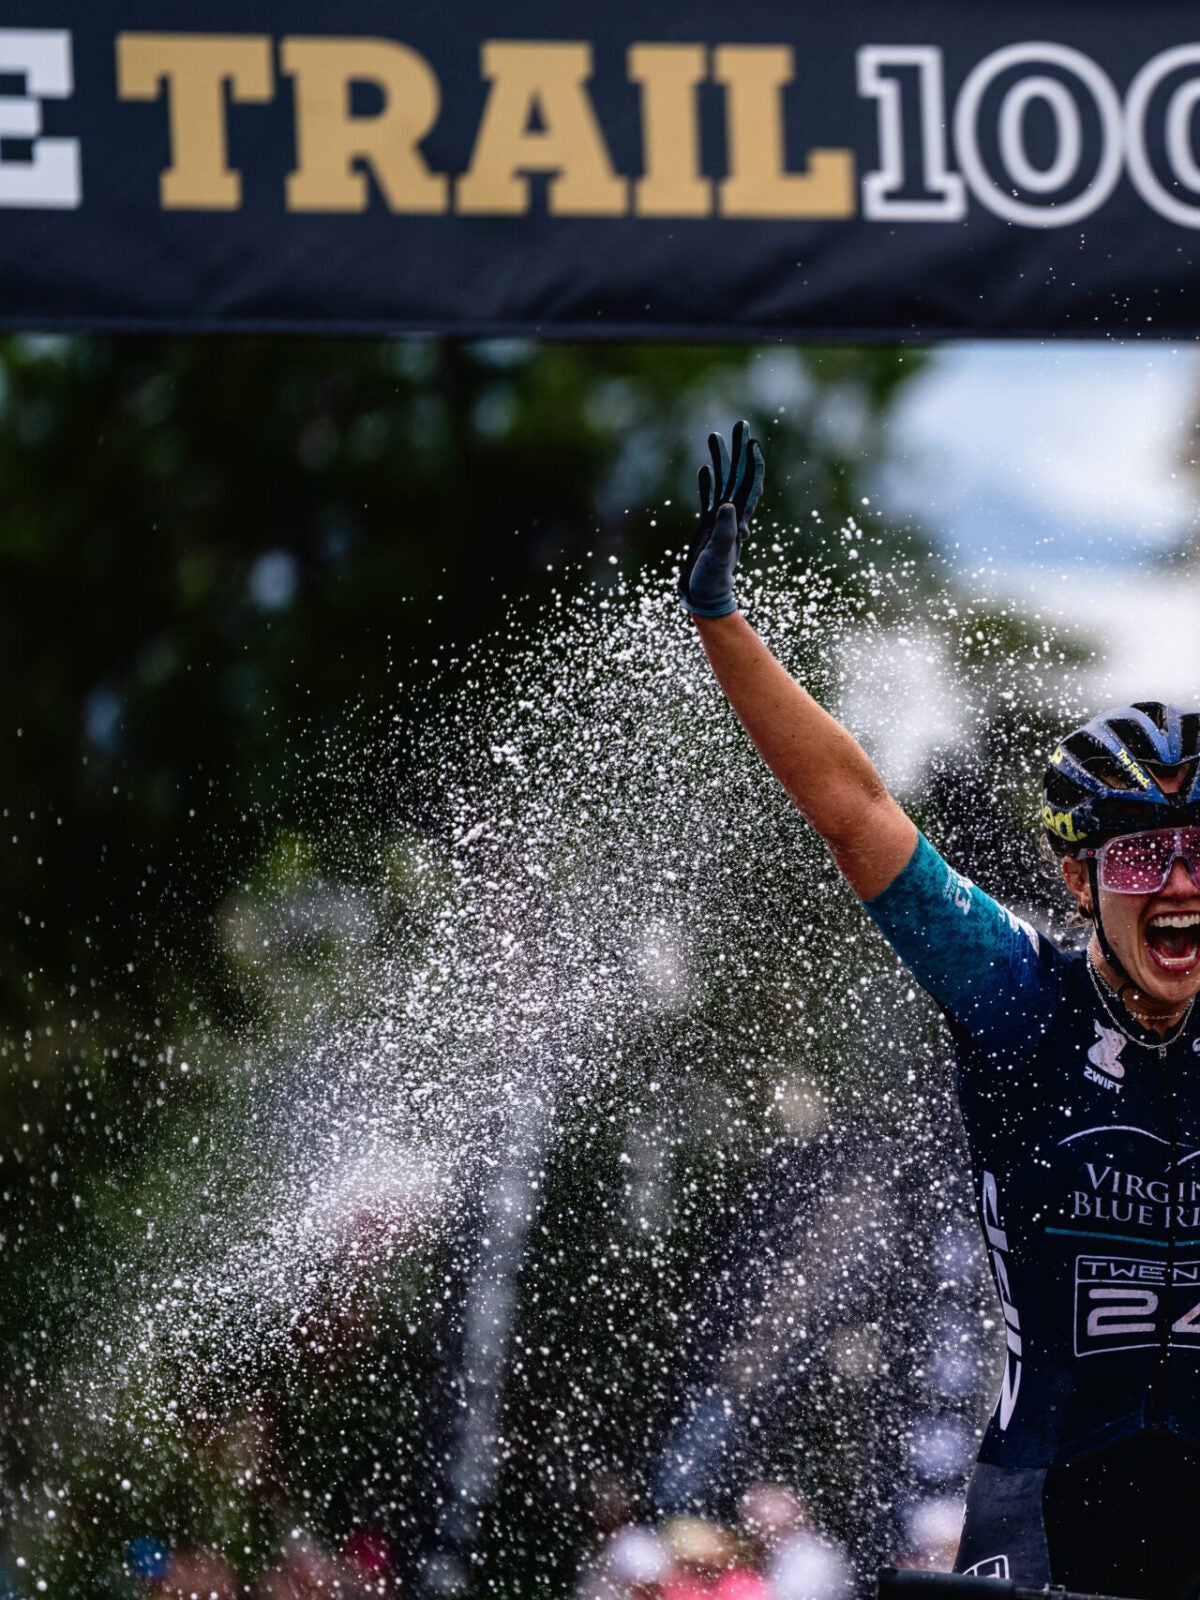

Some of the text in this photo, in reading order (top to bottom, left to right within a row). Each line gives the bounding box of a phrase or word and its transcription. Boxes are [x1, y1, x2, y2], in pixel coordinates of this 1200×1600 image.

[116, 32, 856, 219] TRAIL
[1117, 748, 1131, 765] The
[1083, 1065, 1123, 1094] ZWIFT
[1073, 1191, 1153, 1226] BLUE
